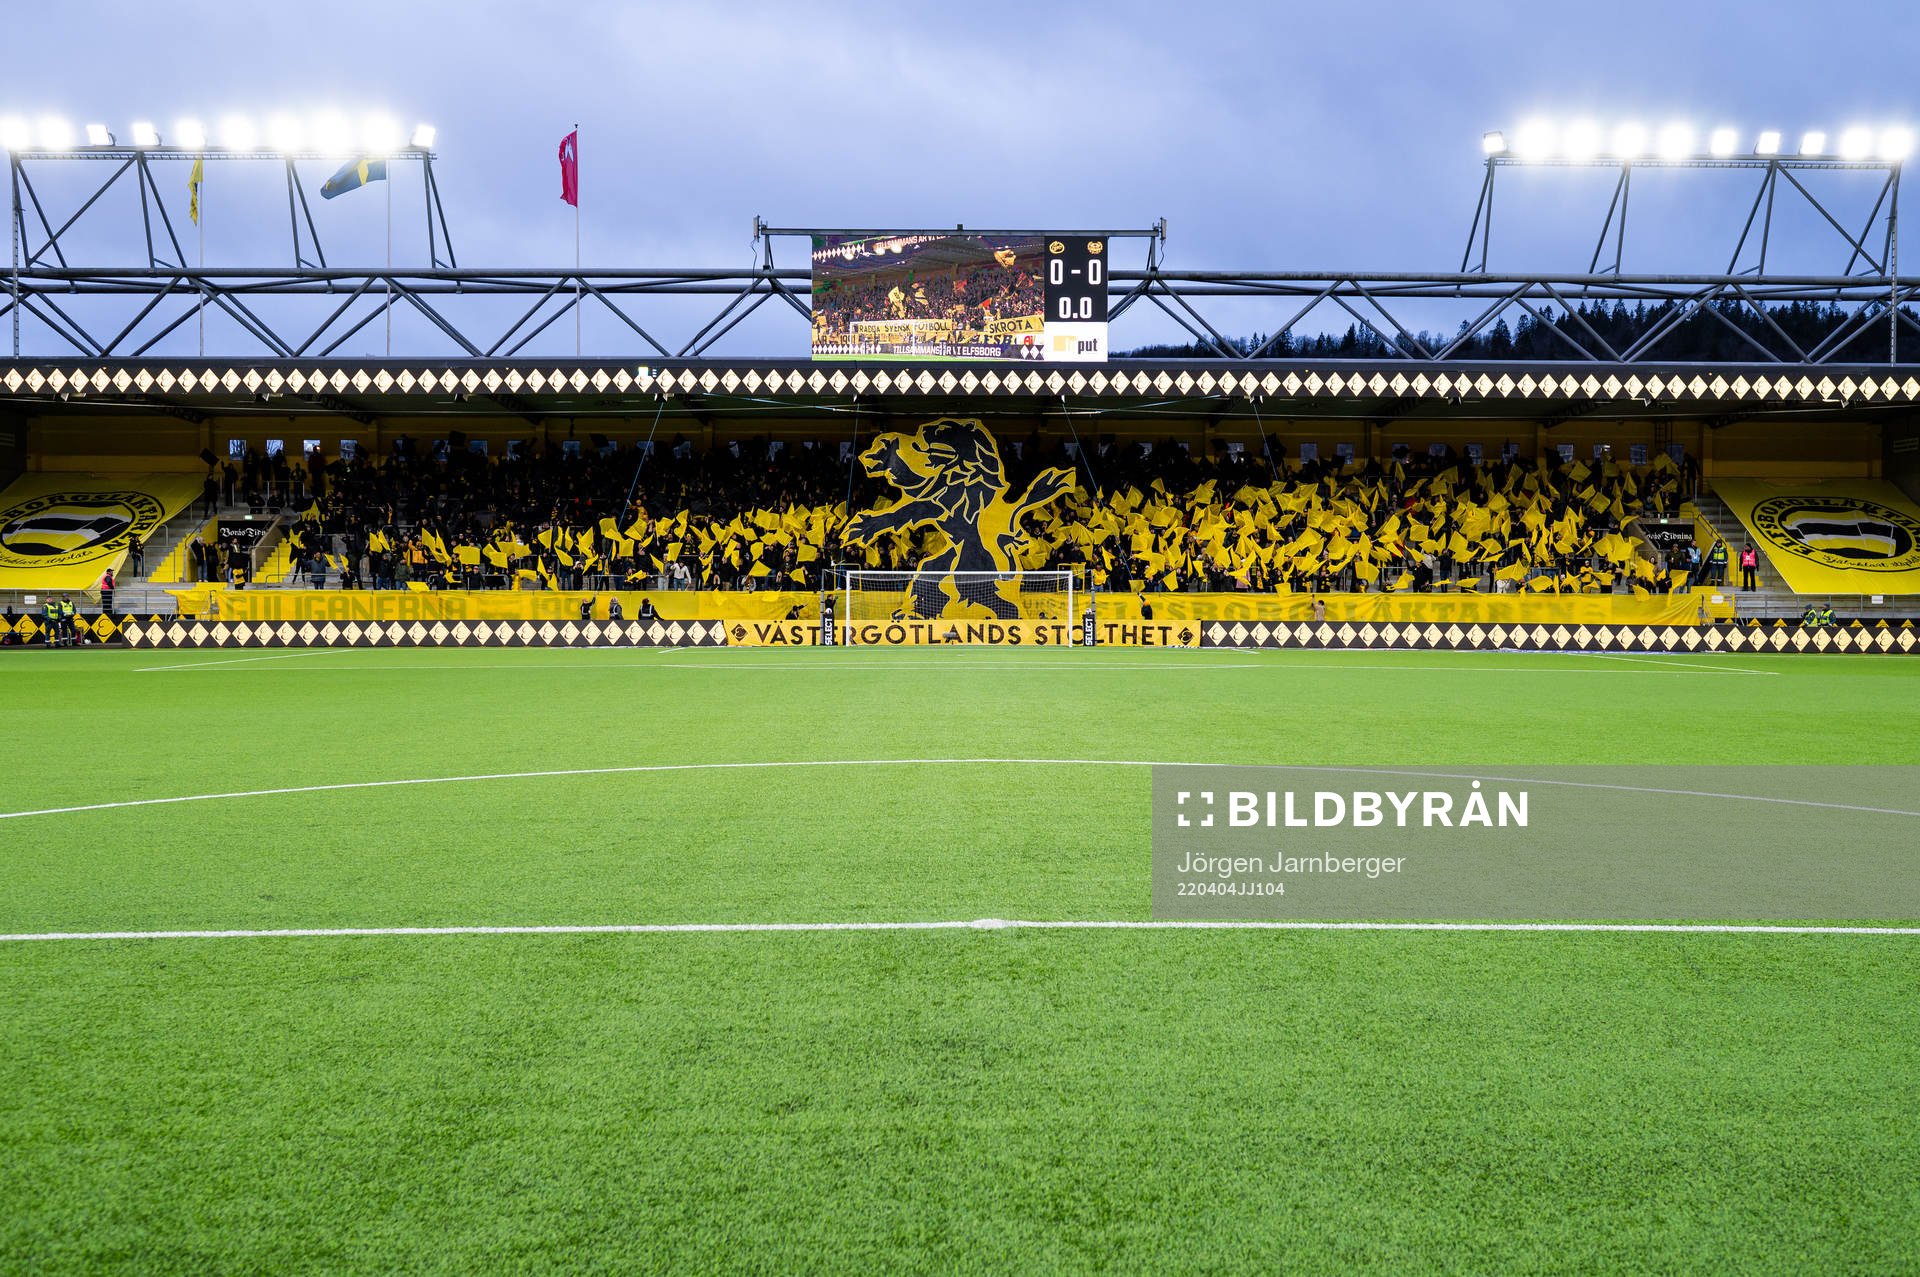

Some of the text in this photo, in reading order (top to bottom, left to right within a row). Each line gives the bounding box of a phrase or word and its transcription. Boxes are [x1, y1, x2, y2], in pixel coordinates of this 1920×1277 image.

[1050, 259, 1064, 285] 0
[1088, 259, 1101, 285] 0
[1059, 297, 1092, 319] 0.0
[989, 320, 1033, 334] SKROTA
[962, 346, 1001, 357] ELFSBORG
[754, 620, 1022, 645] VÄSTRGÖTLANDS
[824, 617, 833, 646] SELECT
[1085, 617, 1094, 646] SELECT
